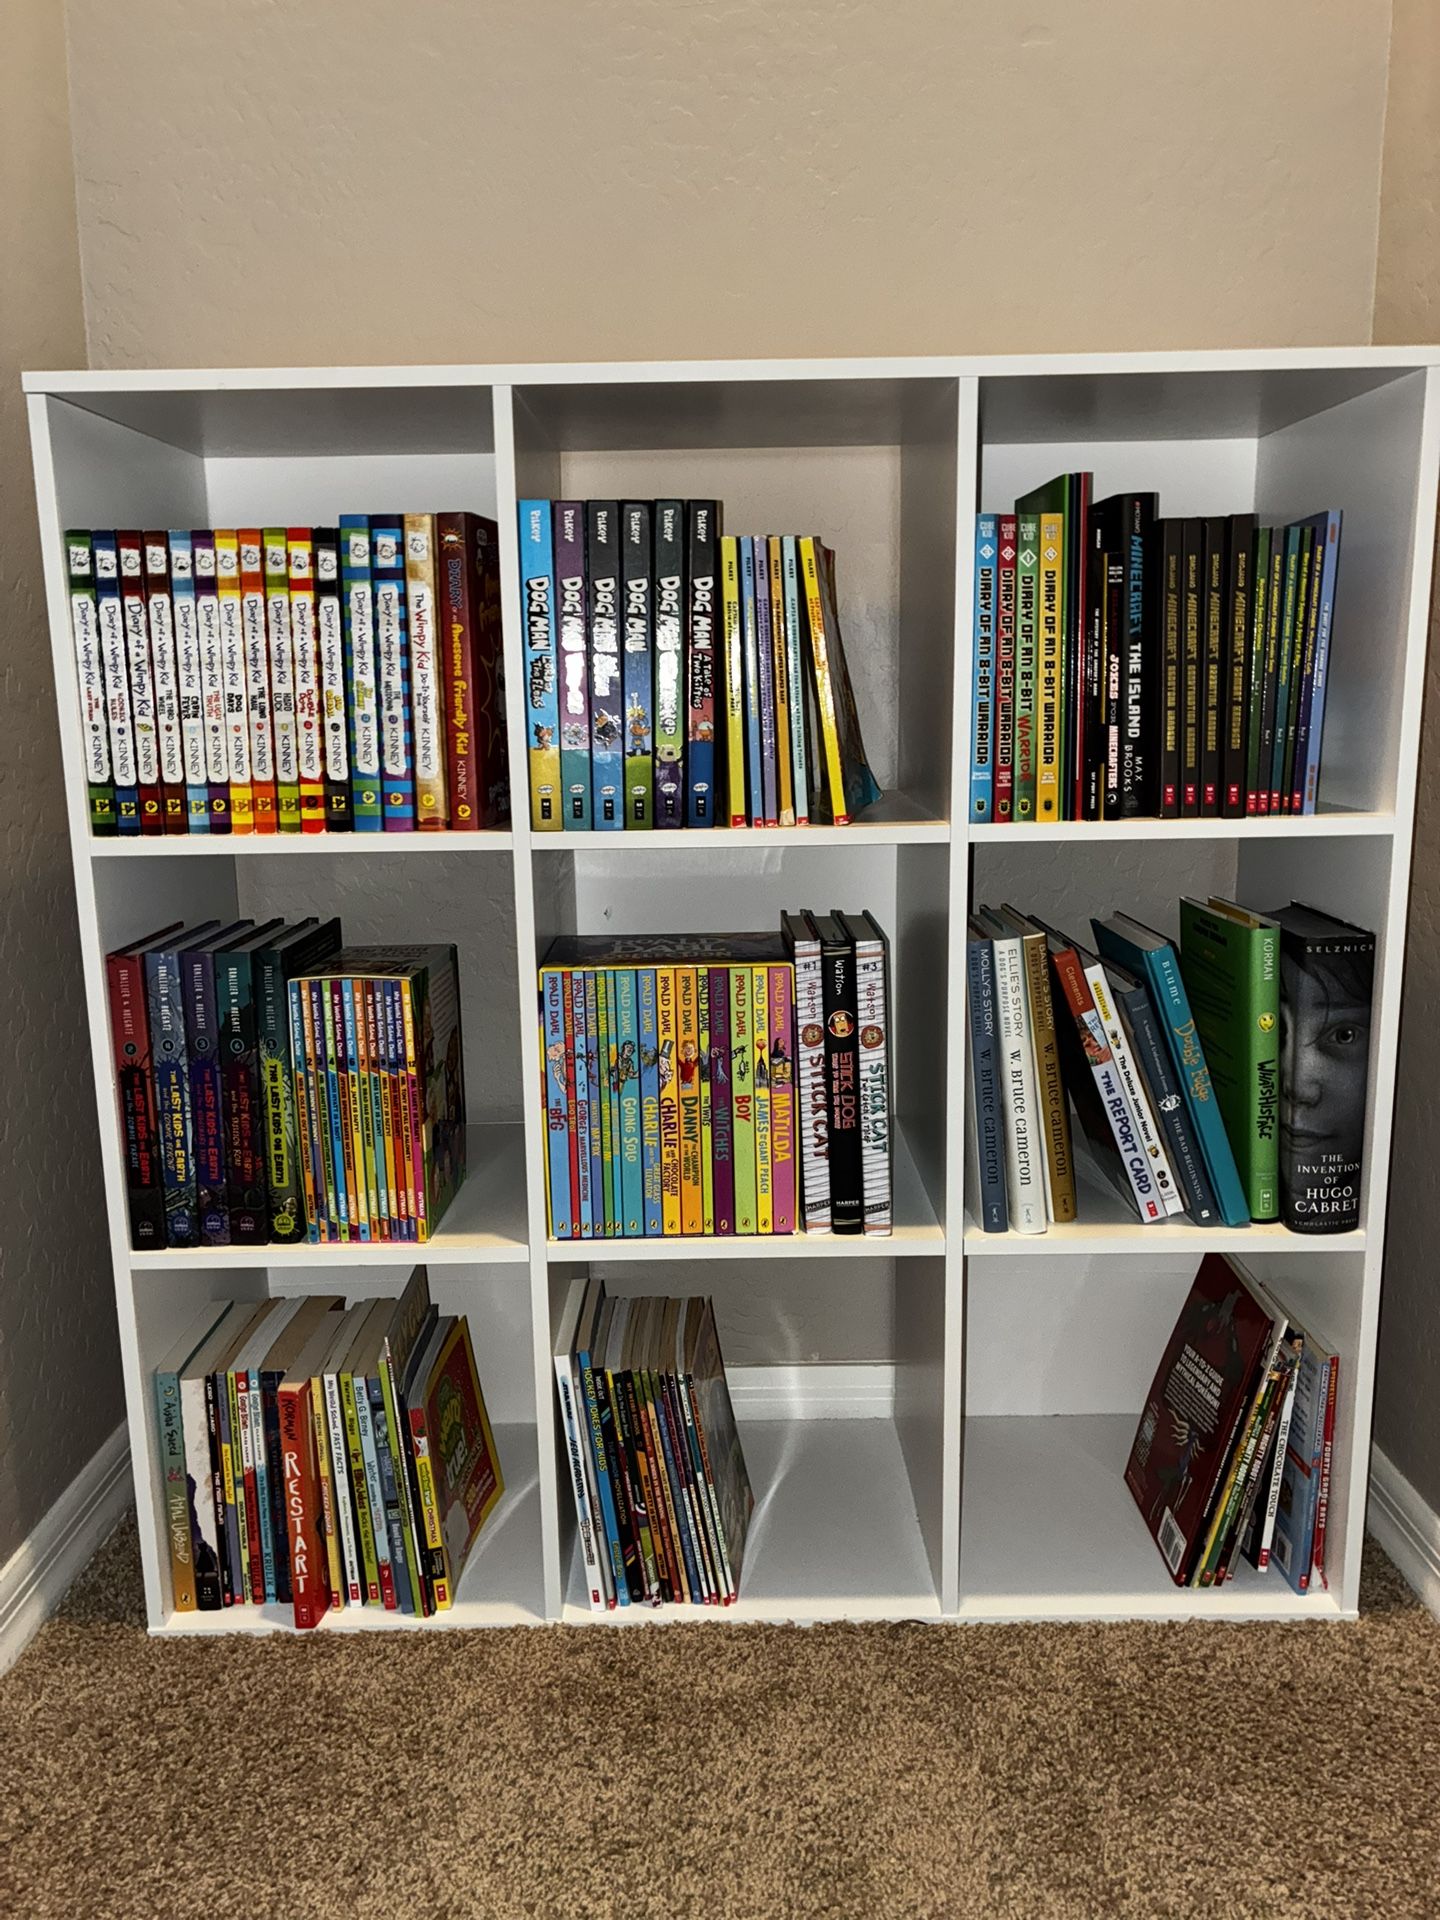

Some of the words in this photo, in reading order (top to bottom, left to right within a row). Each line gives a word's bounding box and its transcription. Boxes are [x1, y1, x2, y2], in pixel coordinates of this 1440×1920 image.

[448, 559, 462, 609] DIARY
[526, 576, 550, 613] DOG
[562, 576, 583, 613] DOG
[626, 578, 648, 614] DOG
[659, 576, 680, 613] DOG
[692, 576, 713, 612] DOG
[980, 568, 992, 611] DIARY
[1001, 569, 1013, 612] DIARY
[1021, 575, 1034, 620] DIARY
[1045, 570, 1056, 612] DIARY
[1129, 535, 1142, 635] MINECRAFT
[128, 603, 142, 637] Diary
[414, 609, 427, 648] Wimpy
[529, 616, 550, 651] MAN
[625, 617, 647, 653] MAN
[693, 615, 712, 650] MAN
[1021, 624, 1034, 643] OF
[1045, 616, 1056, 634] OF
[1187, 593, 1197, 660] MINECRAFT
[1209, 592, 1219, 660] MINECRAFT
[1234, 591, 1245, 663] MINECRAFT
[417, 651, 431, 669] Kid
[451, 623, 464, 677] Awesome
[979, 637, 990, 655] AN
[1001, 638, 1013, 656] AN
[1021, 647, 1033, 667] AN
[1044, 638, 1055, 656] AN
[1129, 643, 1140, 674] THE
[133, 660, 147, 696] Wimpy
[978, 659, 990, 697] 8-BIT
[1021, 671, 1032, 712] 8-BIT
[1044, 661, 1055, 699] 8-BIT
[137, 699, 151, 717] Kid
[274, 693, 283, 712] LUCK
[283, 693, 292, 711] HARD
[453, 681, 466, 729] Friendly
[1127, 679, 1141, 738] ISLAND
[182, 696, 191, 719] FEVER
[190, 738, 199, 777] KINNEY
[421, 728, 431, 770] KINNEY
[456, 733, 468, 754] Kid
[976, 701, 989, 764] WARRIOR
[1000, 702, 1012, 765] WARRIOR
[1043, 702, 1055, 765] WARRIOR
[142, 737, 153, 777] KINNEY
[212, 736, 222, 776] KINNEY
[234, 736, 244, 776] KINNEY
[257, 734, 267, 774] KINNEY
[282, 735, 291, 775] KINNEY
[305, 732, 314, 772] KINNEY
[1108, 725, 1118, 789] MINECRAFTERS
[1123, 745, 1134, 792] BROOKS
[1134, 756, 1142, 782] MAX
[457, 760, 466, 800] KINNEY
[1263, 938, 1273, 980] KORMAN
[1306, 943, 1374, 953] SELZNICK
[834, 960, 845, 995] Watson
[980, 949, 991, 997] MOLLY'S
[1008, 949, 1019, 993] ELLIE'S
[1039, 944, 1050, 993] BAILEY'S
[1045, 997, 1055, 1031] STORY
[1066, 966, 1085, 1006] Clements
[661, 976, 669, 1006] ROALD
[682, 976, 691, 1005] ROALD
[550, 1011, 558, 1036] DAHL
[661, 1011, 670, 1035] DAHL
[683, 1010, 691, 1035] DAHL
[775, 1007, 784, 1032] DAHL
[983, 999, 993, 1037] STORY
[1012, 997, 1023, 1038] STORY
[840, 1052, 853, 1092] STICK
[1174, 1018, 1200, 1064] Double
[1190, 1065, 1210, 1102] Fudge
[171, 1085, 181, 1111] LAST
[204, 1084, 214, 1108] LAST
[270, 1086, 280, 1110] LAST
[810, 1054, 828, 1116] STICK
[869, 1062, 885, 1114] STICK
[1101, 1071, 1116, 1096] THE
[1117, 1055, 1127, 1070] The
[1124, 1071, 1137, 1096] Deluxe
[1132, 1097, 1145, 1120] Junior
[1139, 1120, 1152, 1142] Novel
[1257, 1059, 1277, 1139] WHATSHISFACE
[173, 1113, 184, 1137] KIDS
[272, 1113, 282, 1136] KIDS
[550, 1108, 564, 1131] BFG
[623, 1097, 636, 1133] GOING
[643, 1097, 657, 1146] CHARLIE
[661, 1097, 676, 1148] CHARLIE
[682, 1096, 698, 1142] DANNY
[735, 1095, 751, 1122] BOY
[756, 1096, 769, 1132] JAMES
[841, 1095, 856, 1129] DOG
[1107, 1097, 1137, 1153] REPORT
[134, 1088, 145, 1113] LAST
[140, 1152, 149, 1183] EARTH
[274, 1138, 282, 1151] ON
[715, 1107, 729, 1160] WITCHES
[772, 1093, 791, 1162] MATILDA
[812, 1120, 829, 1160] CAT
[871, 1118, 887, 1152] CAT
[175, 1150, 185, 1181] EARTH
[624, 1137, 637, 1162] SOLO
[760, 1141, 768, 1165] GIANT
[1321, 1154, 1343, 1162] THE
[274, 1154, 284, 1183] EARTH
[670, 1159, 678, 1196] CHOCOLATE
[683, 1156, 691, 1180] WORLD
[691, 1151, 699, 1186] CHAMPION
[761, 1168, 769, 1193] PEACH
[1129, 1159, 1151, 1195] CARD
[1182, 1154, 1203, 1200] BEGINNING
[1298, 1162, 1360, 1174] INVENTION
[1295, 1198, 1359, 1213] CABRET
[1306, 1186, 1352, 1199] HUGO
[344, 1381, 352, 1405] Warner
[355, 1386, 366, 1404] Betty
[584, 1368, 596, 1401] HOCKEY
[1208, 1368, 1224, 1386] GUIDE
[1329, 1366, 1337, 1405] SPINELLI
[282, 1399, 296, 1440] KORMAN
[358, 1414, 369, 1437] Birney
[590, 1405, 600, 1429] JOKES
[1280, 1420, 1289, 1436] THE
[333, 1433, 341, 1450] FAST
[594, 1433, 603, 1449] FOR
[1323, 1441, 1332, 1474] FOURTH
[335, 1451, 344, 1474] FACTS
[597, 1451, 608, 1471] KIDS
[1272, 1439, 1287, 1488] CHOCOLATE
[170, 1495, 184, 1520] AMAL
[615, 1479, 627, 1525] NOVELIZATION
[1268, 1490, 1278, 1518] TOUCH
[1320, 1477, 1329, 1503] GRADE
[284, 1451, 308, 1594] RESTART
[427, 1508, 437, 1543] CHRISTMAS
[263, 1552, 274, 1586] KRULIK
